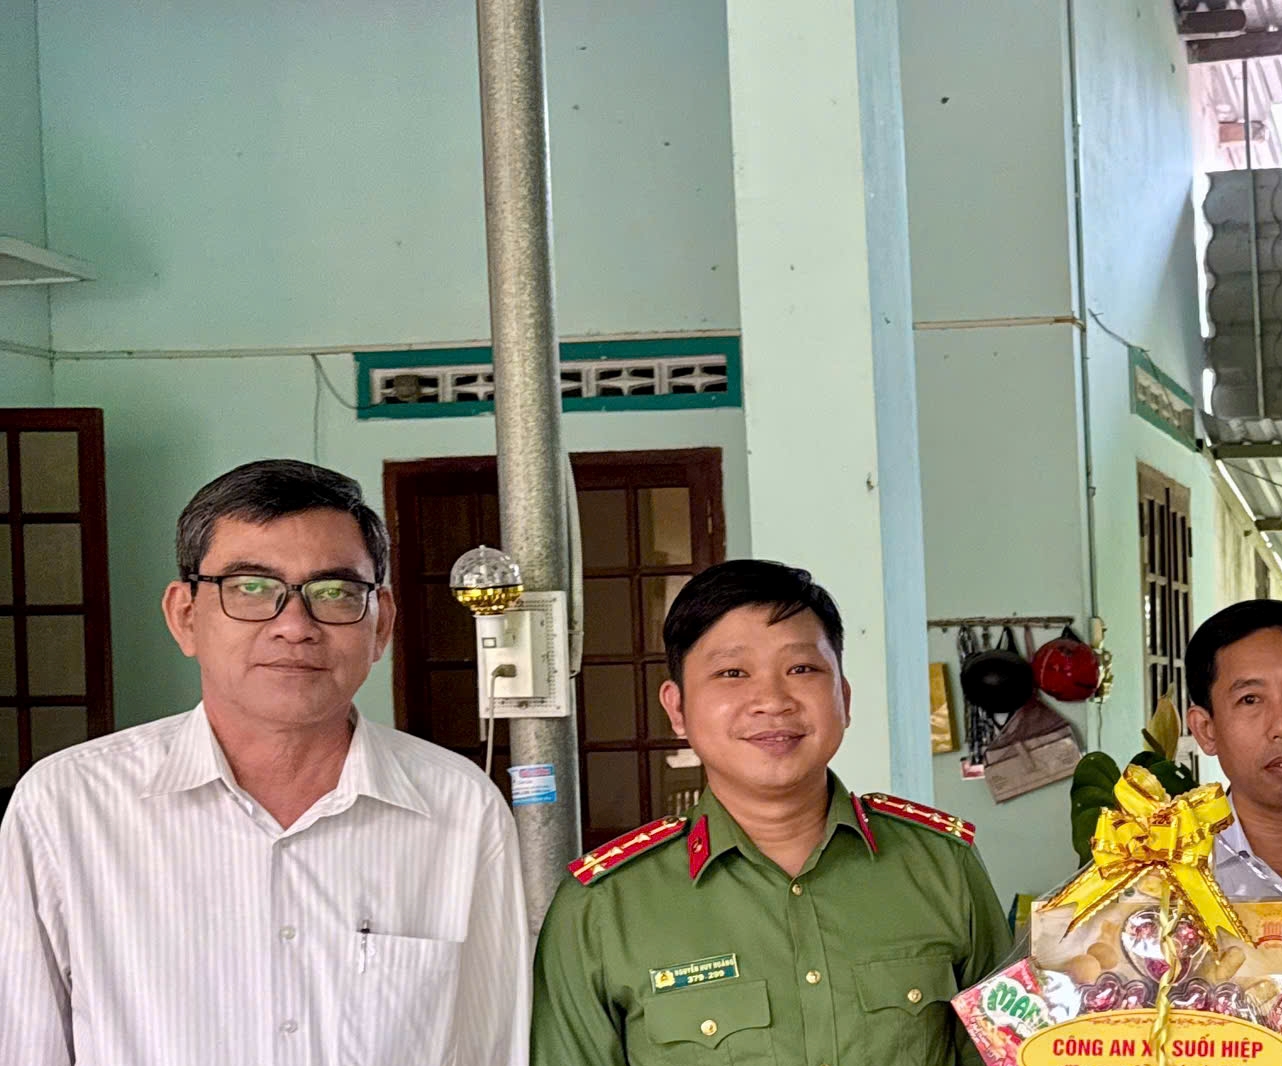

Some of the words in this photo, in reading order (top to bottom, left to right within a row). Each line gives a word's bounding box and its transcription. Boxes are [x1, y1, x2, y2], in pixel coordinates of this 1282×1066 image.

[1053, 1035, 1104, 1057] CÔNG
[1109, 1039, 1135, 1057] AN
[1172, 1034, 1215, 1058] SUỐI
[1221, 1037, 1263, 1062] HIỆP
